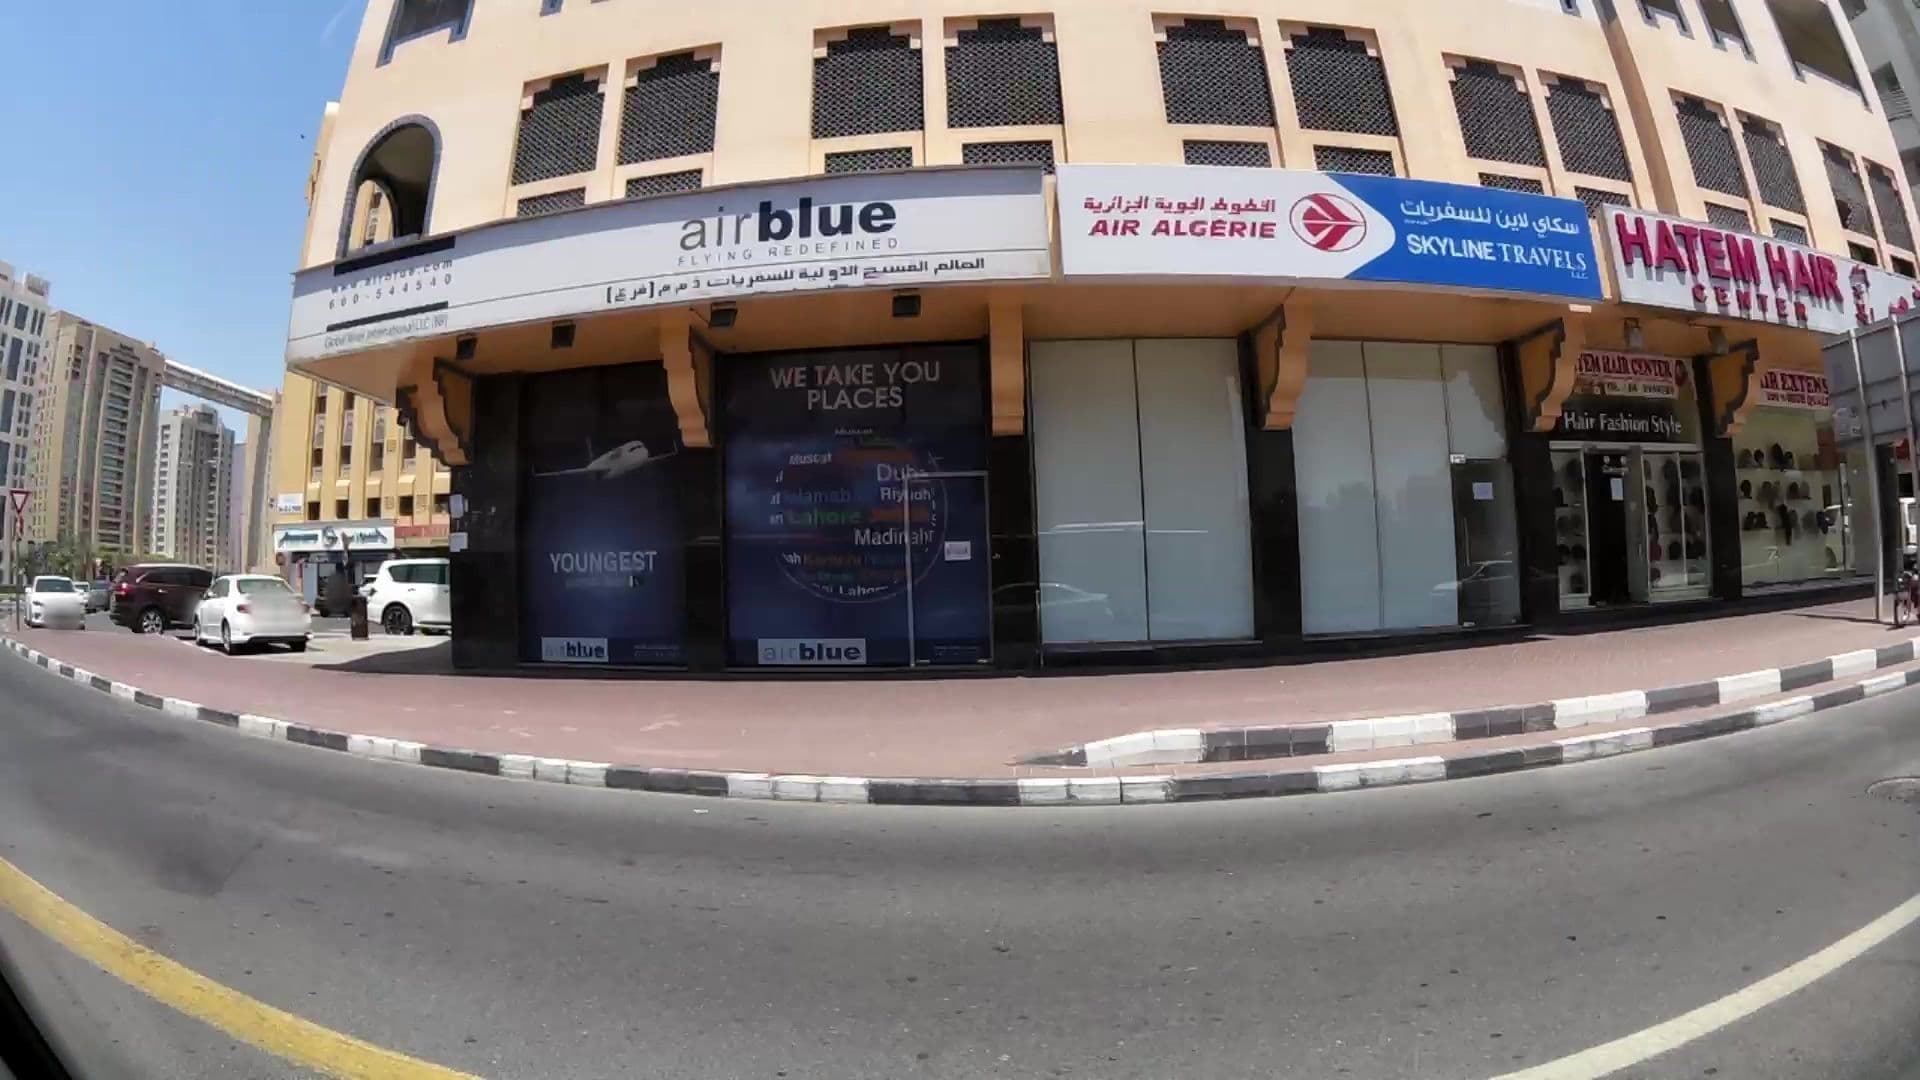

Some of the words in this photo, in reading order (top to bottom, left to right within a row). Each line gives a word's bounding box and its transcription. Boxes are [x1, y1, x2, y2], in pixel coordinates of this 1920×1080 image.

[1083, 195, 1150, 214] الجزائرية
[1154, 196, 1206, 215] الجوية
[1400, 199, 1492, 225] للسفريات
[679, 197, 897, 252] airblue
[1088, 219, 1141, 237] AIR
[1495, 209, 1529, 232] لاين
[1532, 215, 1580, 239] سكاي
[677, 249, 752, 267] FLYING
[768, 237, 898, 258] REDEFINED
[1406, 232, 1497, 262] SKYLINE
[1497, 242, 1588, 272] TRAVELS
[1614, 212, 1761, 286] HATEM
[1763, 241, 1844, 306] HAIR
[1691, 282, 1808, 322] CENTER
[1576, 352, 1600, 373] TEM
[769, 366, 807, 389] WE
[813, 363, 874, 386] TAKE
[883, 361, 940, 385] YOU
[1780, 373, 1829, 394] EXTENS
[807, 386, 904, 411] PLACES
[1563, 410, 1597, 431] Hair
[1599, 411, 1649, 433] Fashion
[1650, 414, 1682, 438] Style
[549, 550, 658, 574] YOUNGEST
[544, 641, 605, 659] blue
[763, 643, 863, 663] airblue
